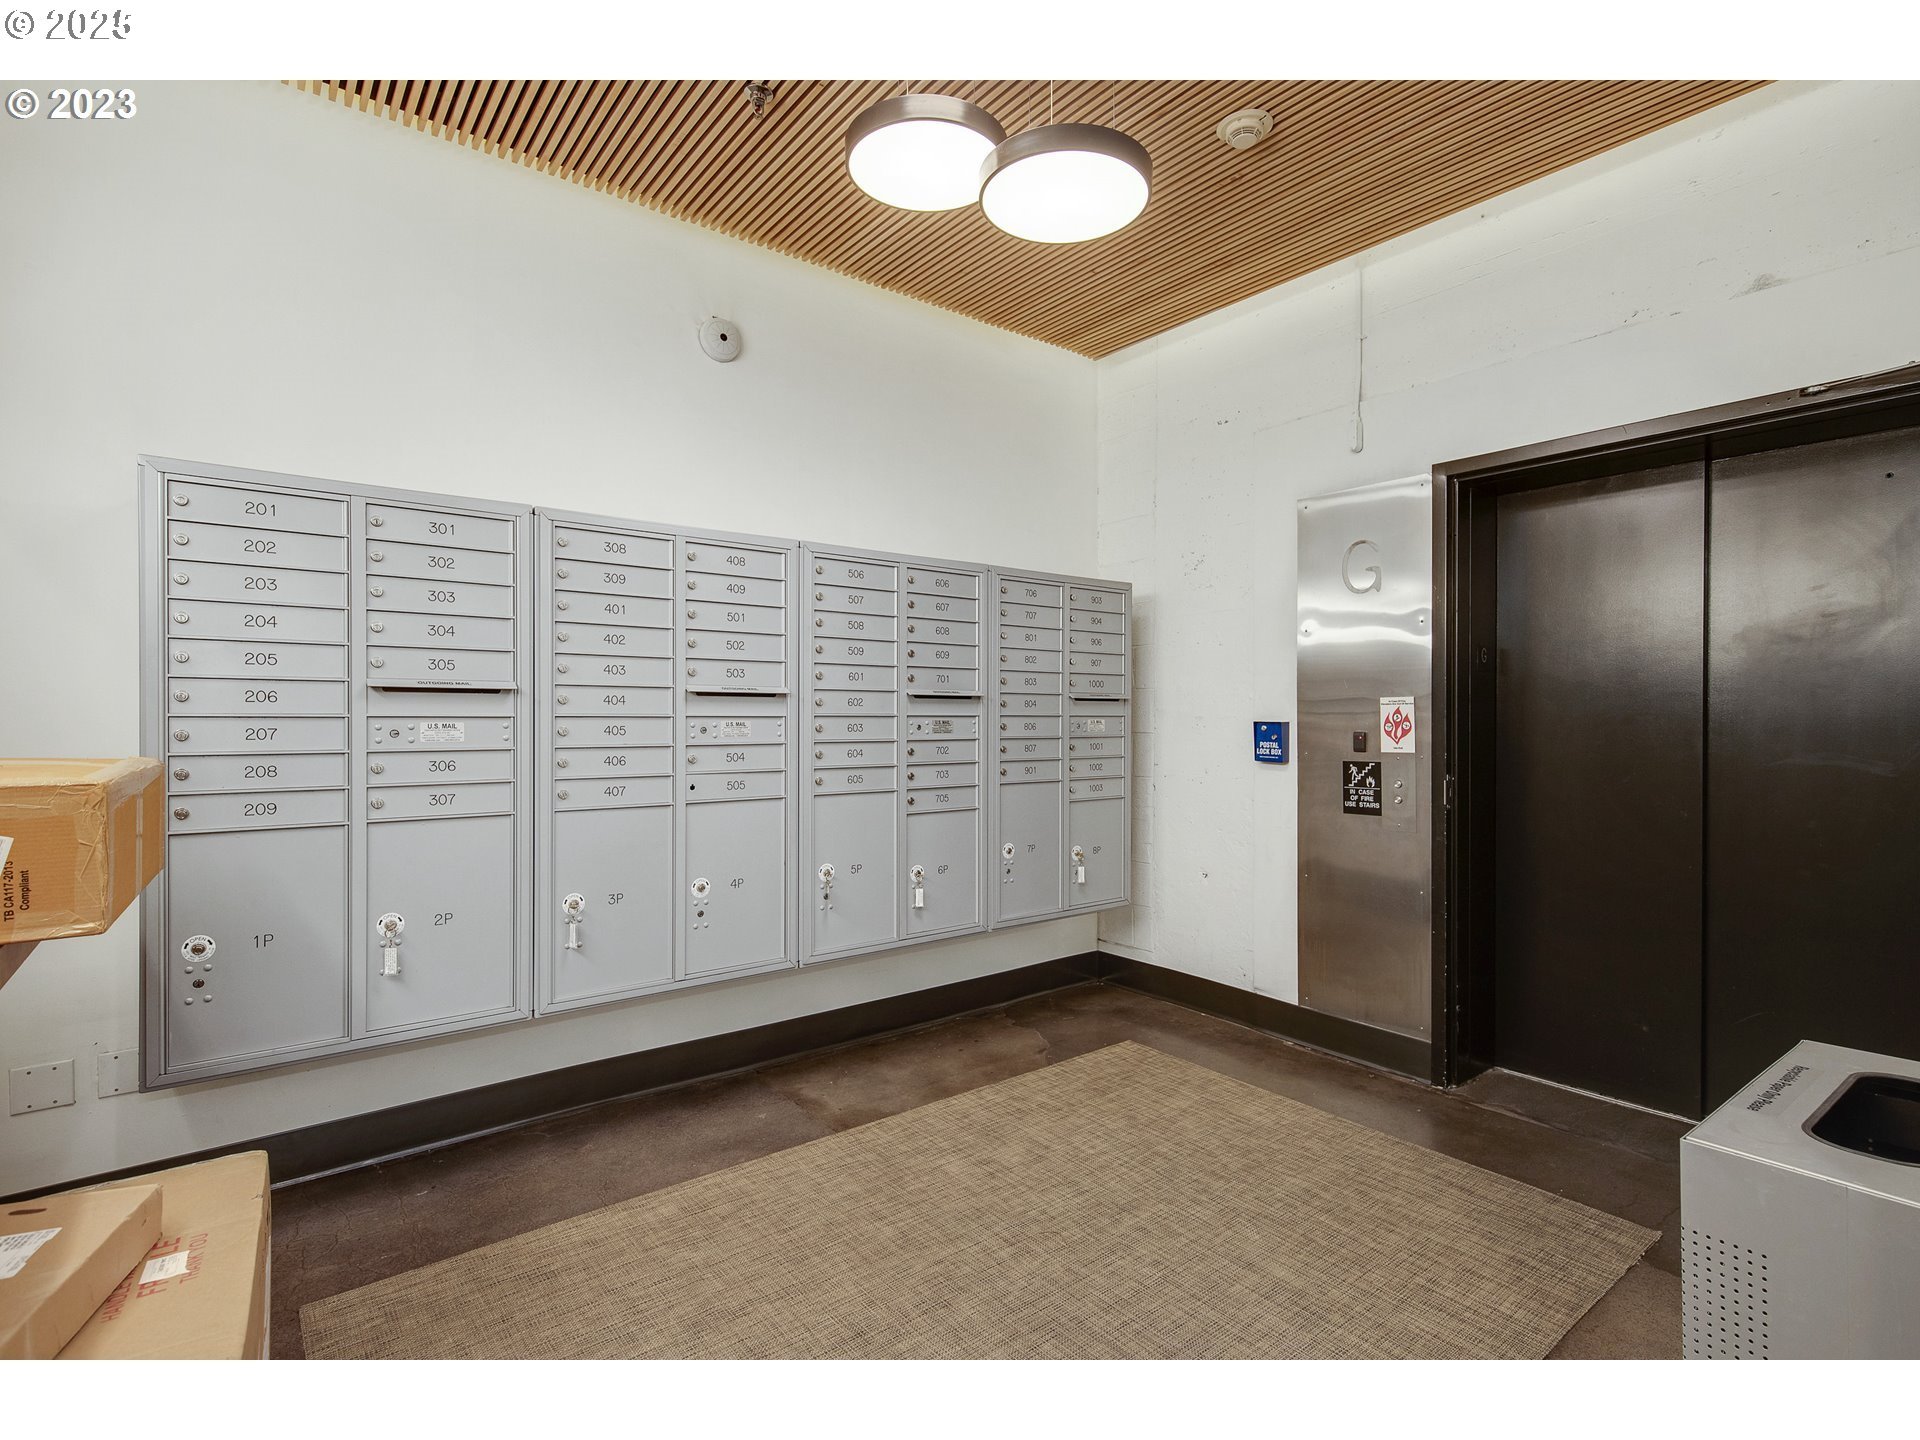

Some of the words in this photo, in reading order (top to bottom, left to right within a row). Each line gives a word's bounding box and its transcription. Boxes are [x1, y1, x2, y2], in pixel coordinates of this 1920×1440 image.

[244, 501, 276, 517] 201
[428, 521, 455, 536] 301
[243, 539, 277, 555] 202
[603, 541, 627, 555] 308
[427, 555, 456, 570] 302
[726, 555, 746, 567] 408
[1341, 539, 1382, 594] G
[603, 572, 627, 585] 309
[847, 568, 865, 580] 506
[244, 576, 278, 592] 203
[726, 583, 746, 595] 409
[935, 578, 950, 589] 606
[427, 589, 456, 604] 303
[1024, 588, 1038, 598] 706
[847, 594, 865, 605] 507
[1090, 595, 1103, 605] 903
[604, 603, 626, 615] 401
[935, 602, 950, 612] 607
[726, 611, 745, 623] 501
[1024, 610, 1037, 620] 707
[1090, 616, 1103, 626] 904
[244, 614, 278, 629] 204
[847, 620, 865, 631] 508
[427, 624, 456, 637] 304
[935, 626, 950, 636] 608
[603, 633, 626, 646] 402
[1024, 633, 1037, 642] 801
[1090, 637, 1103, 647] 906
[725, 639, 745, 651] 502
[847, 646, 865, 656] 509
[244, 652, 278, 666] 205
[935, 650, 950, 660] 609
[1024, 655, 1037, 664] 802
[427, 658, 456, 671] 305
[1090, 658, 1102, 668] 907
[603, 664, 627, 676] 403
[725, 668, 746, 679] 503
[848, 671, 864, 682] 601
[935, 674, 950, 684] 701
[1024, 677, 1037, 687] 803
[1088, 679, 1105, 689] 1000
[244, 689, 278, 703] 206
[602, 694, 627, 706] 404
[847, 697, 864, 707] 602
[1024, 699, 1037, 708] 804
[441, 722, 458, 730] MAIL
[603, 725, 627, 737] 405
[847, 723, 864, 733] 603
[1023, 722, 1037, 731] 806
[245, 727, 278, 741] 207
[935, 745, 950, 755] 702
[1024, 743, 1037, 753] 807
[1089, 742, 1104, 751] 1001
[1259, 741, 1280, 749] POSTAL
[725, 752, 745, 763] 504
[846, 748, 864, 759] 604
[428, 759, 457, 773] 306
[603, 755, 627, 767] 406
[1088, 762, 1104, 772] 1002
[244, 764, 278, 779] 208
[935, 769, 950, 779] 703
[1024, 766, 1037, 775] 901
[726, 780, 746, 791] 505
[847, 774, 864, 785] 605
[603, 785, 627, 797] 407
[1089, 783, 1104, 793] 1003
[428, 793, 456, 807] 307
[935, 793, 950, 803] 705
[244, 802, 278, 817] 209
[1358, 801, 1380, 809] STAIRS
[1026, 843, 1036, 853] 7P
[850, 863, 863, 875] 5P
[937, 864, 949, 875] 6P
[3, 860, 15, 909] CA117-2013
[729, 877, 745, 889] 4P
[19, 869, 32, 911] Compliant
[607, 892, 624, 906] 3P
[3, 909, 15, 922] TB
[434, 912, 454, 927] 2P
[253, 933, 274, 949] 1P
[1768, 1080, 1792, 1093] Paper
[1746, 1097, 1773, 1112] Please
[187, 1232, 209, 1254] YOU
